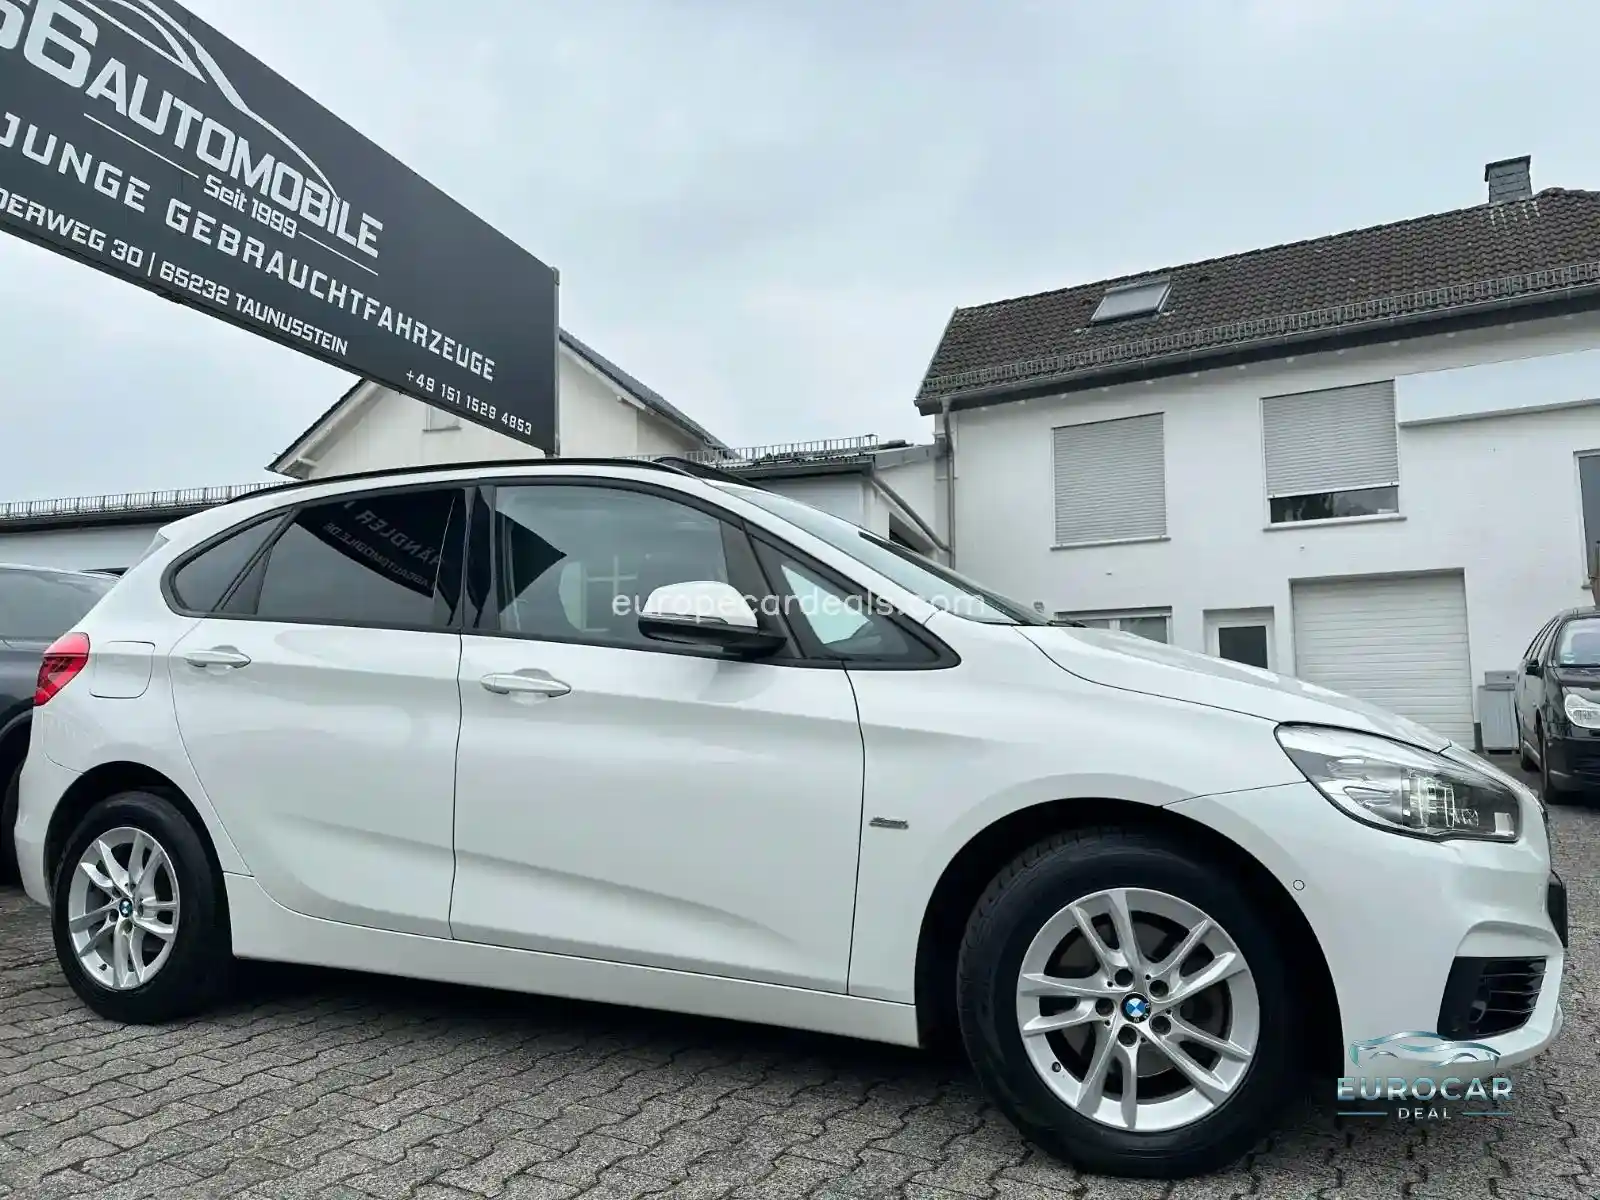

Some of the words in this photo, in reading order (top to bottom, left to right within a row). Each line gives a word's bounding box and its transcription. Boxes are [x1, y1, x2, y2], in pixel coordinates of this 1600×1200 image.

[0, 112, 150, 213] JUNGE
[165, 198, 495, 381] GEBRAUCHTFAHRZEUGE
[203, 174, 247, 213] Seit
[251, 199, 297, 239] 1999
[111, 239, 143, 268] 30
[159, 260, 230, 306] 65232
[235, 292, 348, 356] TAUNUSSTEIN
[406, 370, 435, 392] +49
[441, 383, 460, 404] 151
[466, 395, 497, 420] 1529
[501, 412, 532, 435] 4853
